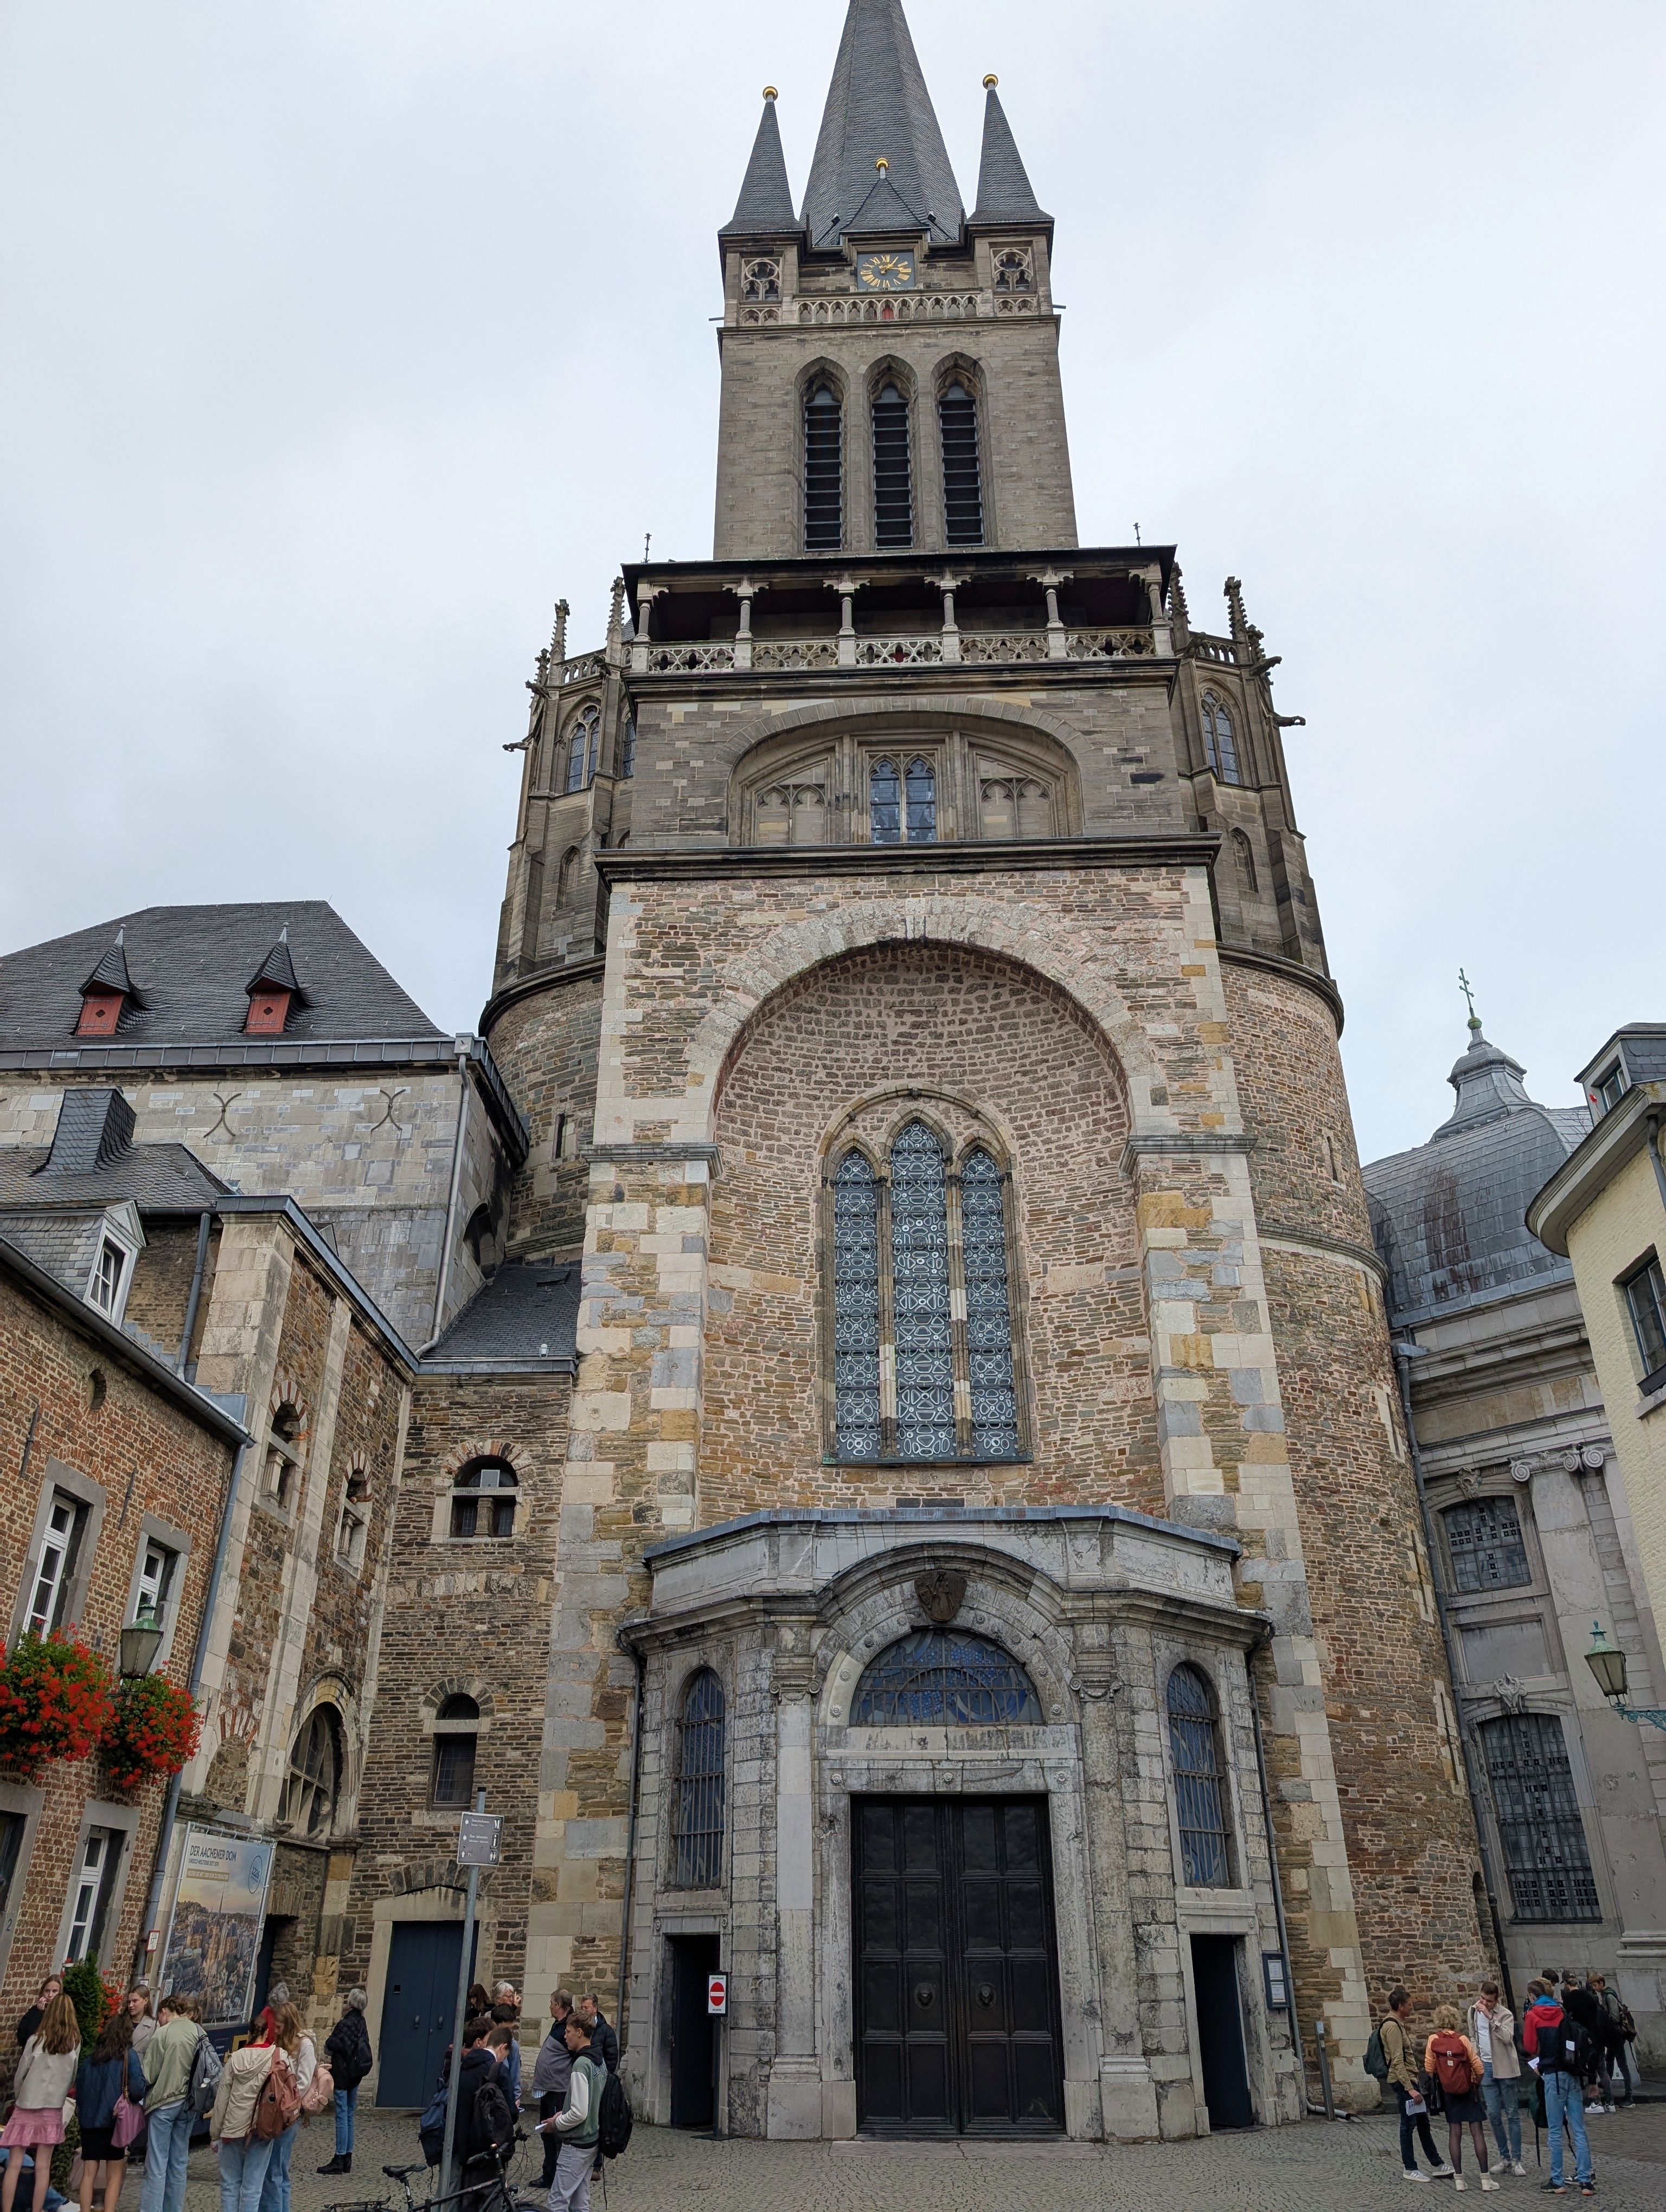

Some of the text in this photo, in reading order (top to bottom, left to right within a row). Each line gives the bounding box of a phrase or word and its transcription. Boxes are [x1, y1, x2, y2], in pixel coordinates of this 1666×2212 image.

[190, 1845, 237, 1861] DER AACHENER DOM
[6, 1918, 12, 1931] 2
